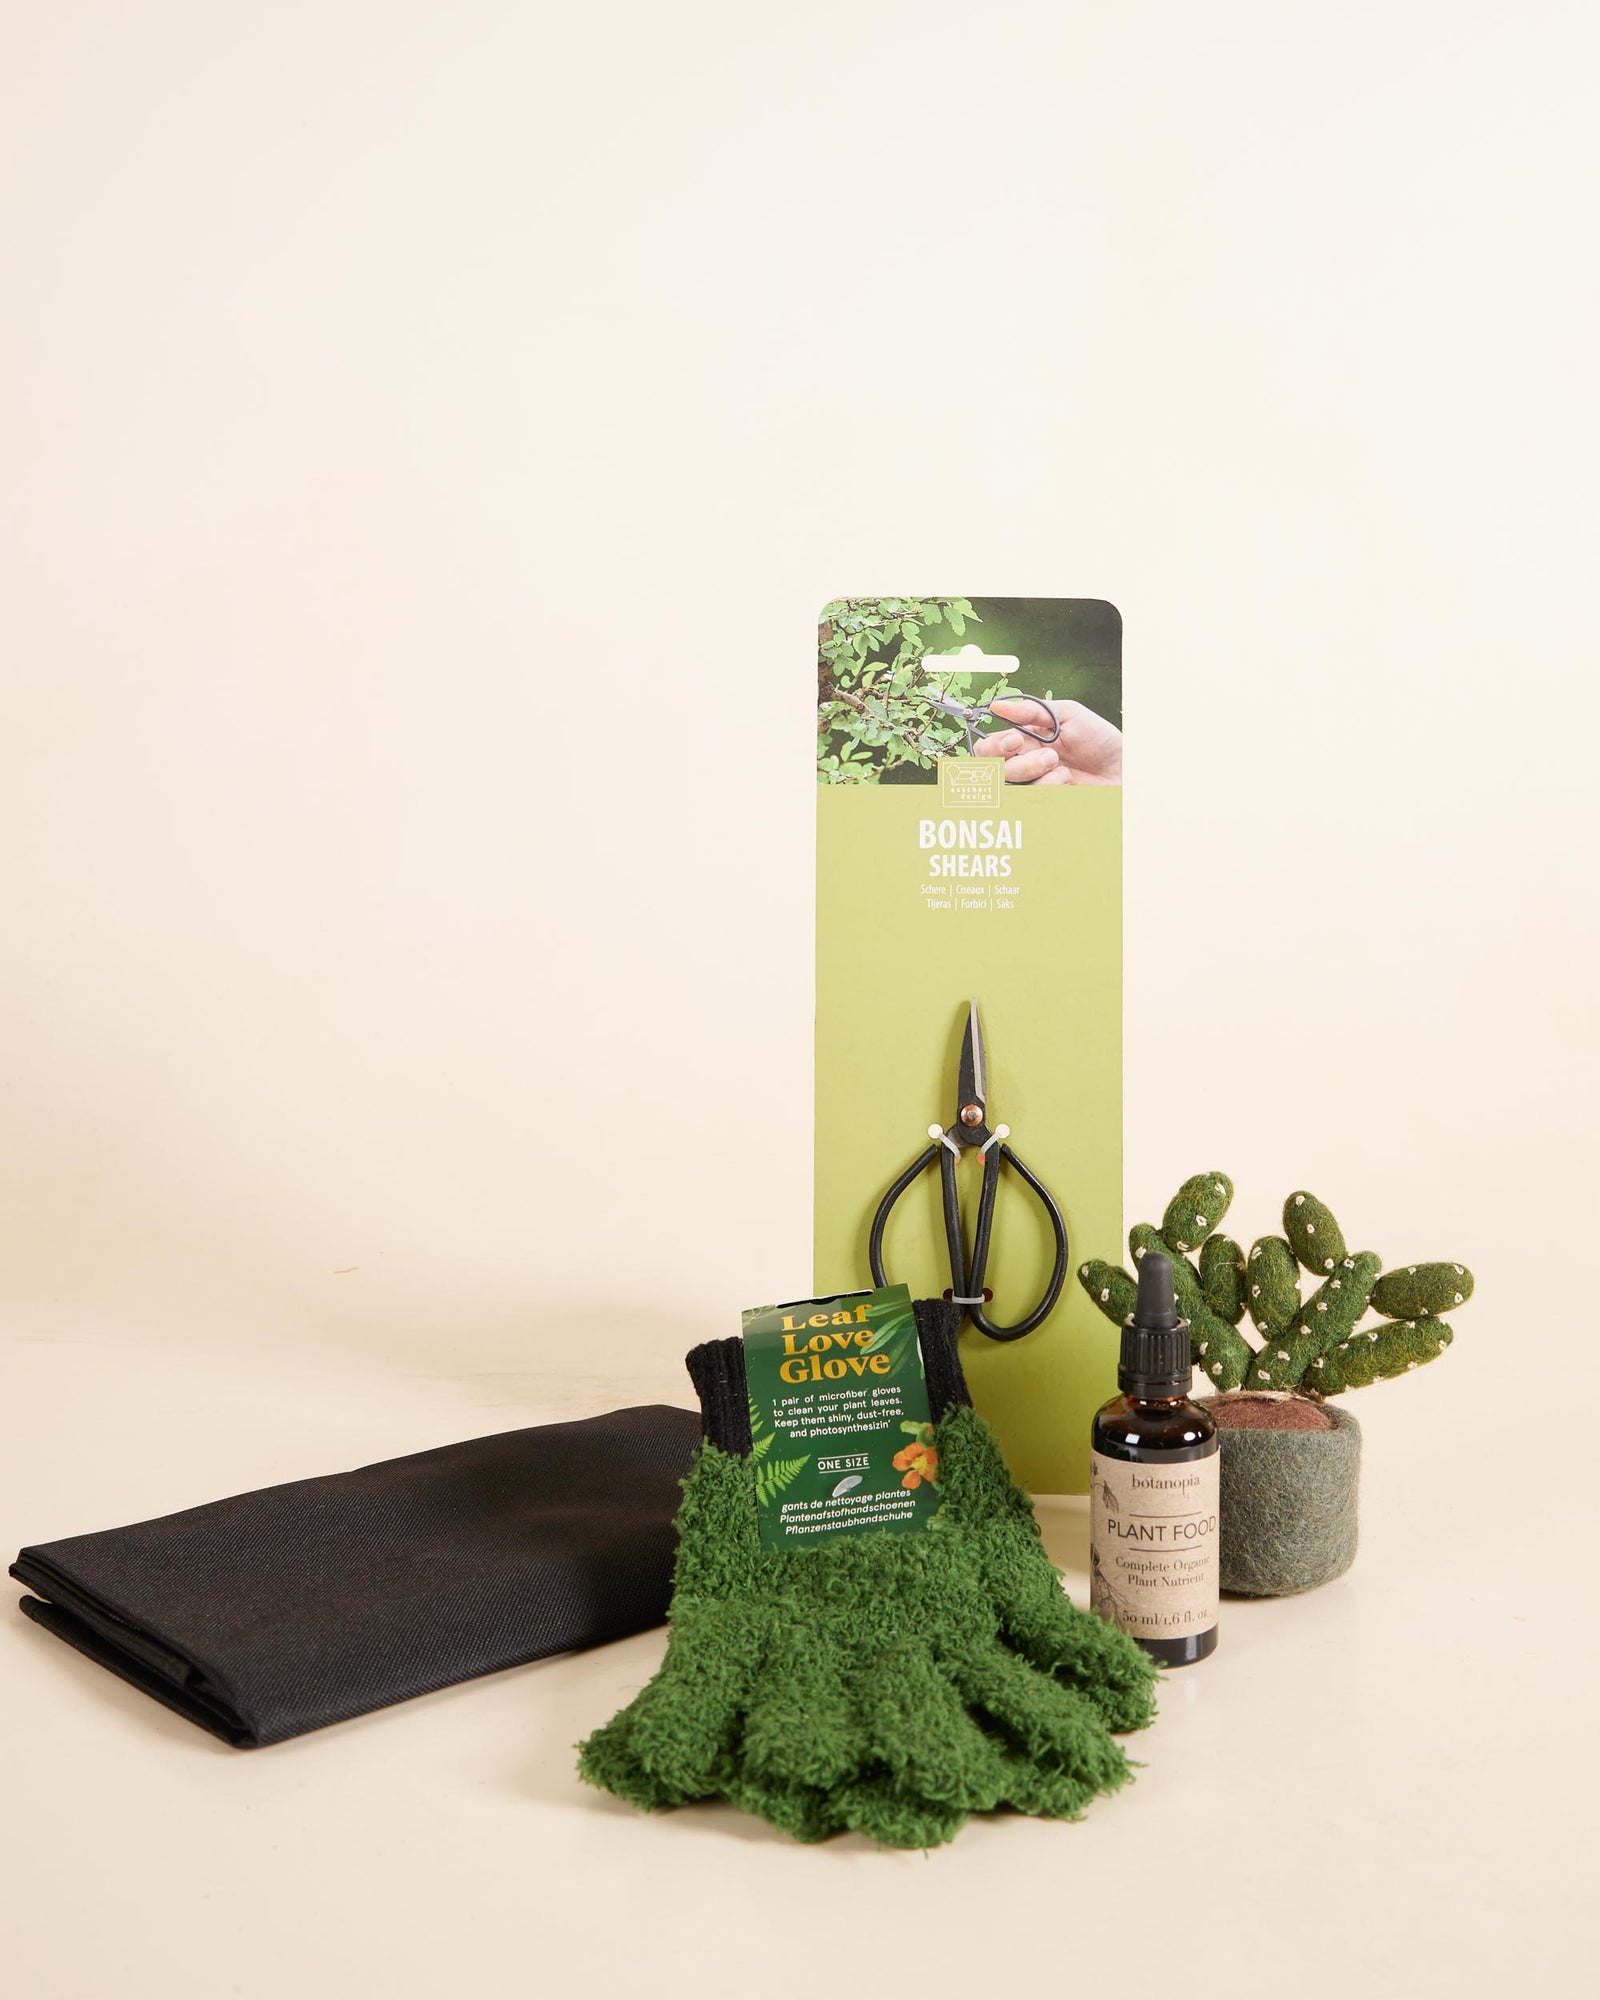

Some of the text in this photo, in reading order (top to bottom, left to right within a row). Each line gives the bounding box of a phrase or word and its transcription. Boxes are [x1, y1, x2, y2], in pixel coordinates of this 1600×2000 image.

[919, 819, 1023, 849] BONSAI
[929, 854, 1012, 877] SHEARS
[920, 884, 1020, 895] Schere Ciseaux Schaar
[927, 898, 1015, 910] Tijeras Forbici Saks
[781, 1303, 873, 1331] Leaf
[781, 1329, 876, 1356] Love
[779, 1353, 891, 1384] Glove
[772, 1386, 902, 1407] 1 pair of microfiber gloves
[773, 1397, 903, 1418] to clean your plant leaves.
[774, 1408, 904, 1429] Keep them shiny, dust-free,
[789, 1428, 808, 1438] and
[817, 1456, 870, 1471] ONE SIZE
[1132, 1473, 1200, 1496] botanopia
[780, 1499, 916, 1524] Plantenafstofhandschoenen
[781, 1488, 911, 1514] gants de nettoyage plantes
[785, 1510, 913, 1536] Pflanzenstaubhandschuhe
[1107, 1516, 1217, 1542] PLANT FOOD
[1115, 1556, 1210, 1574] Complete Organic
[1128, 1573, 1204, 1588] Plant Nutrient
[1122, 1609, 1137, 1623] 50
